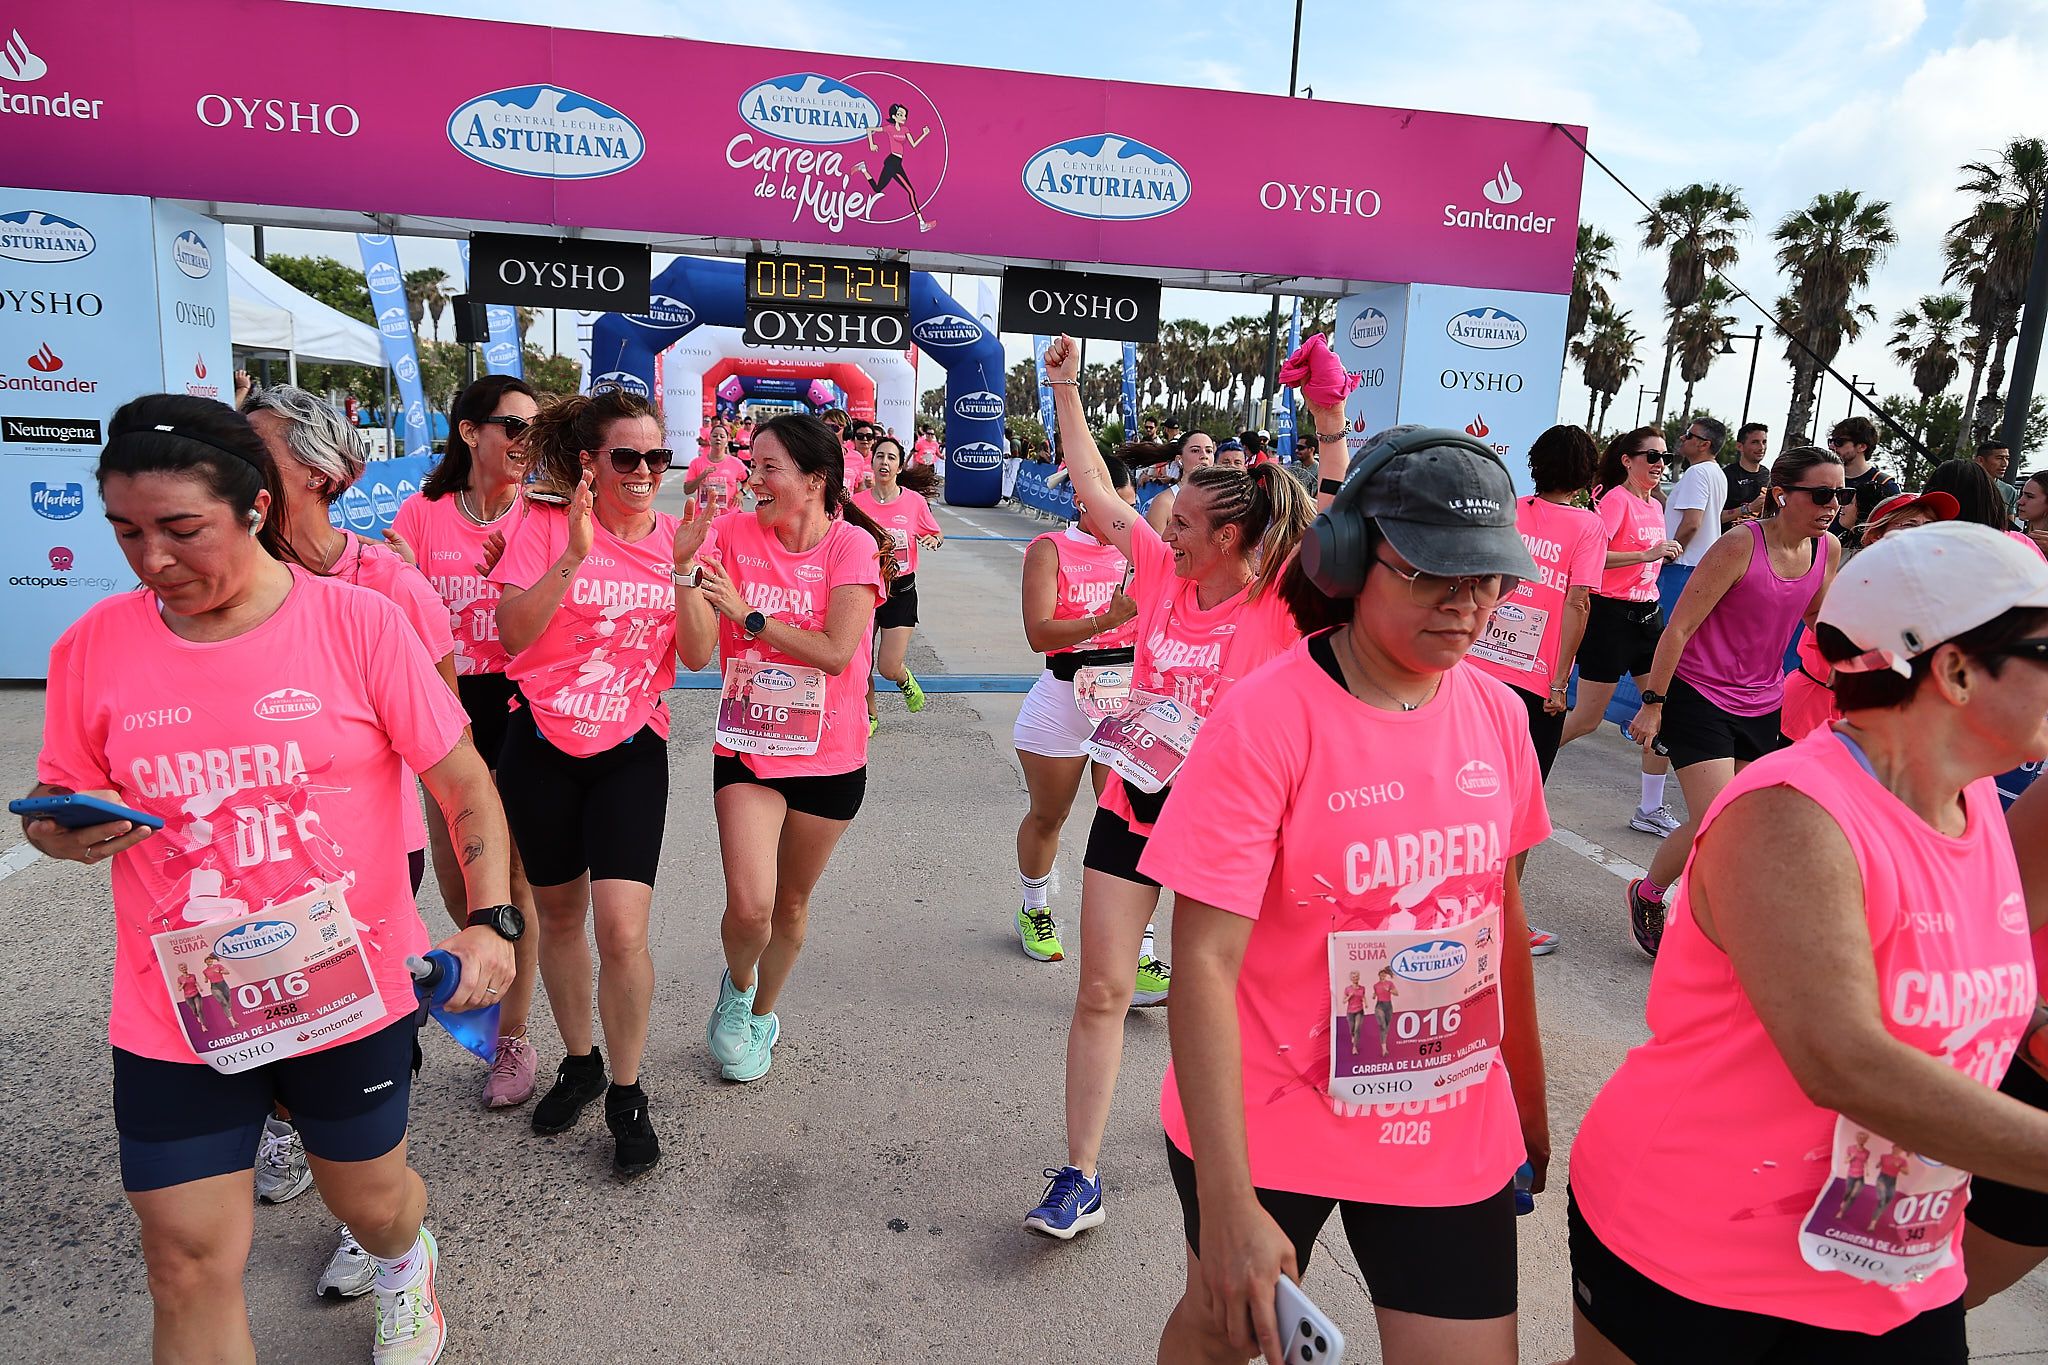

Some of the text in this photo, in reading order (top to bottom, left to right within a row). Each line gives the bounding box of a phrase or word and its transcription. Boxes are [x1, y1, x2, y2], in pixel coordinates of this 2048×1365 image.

[0, 86, 103, 119] tander
[750, 94, 869, 129] ASTURIANA
[772, 94, 867, 109] CENTRAL LECHERA
[196, 94, 360, 137] OYSHO
[494, 113, 624, 133] CENTRAL LECHERA
[464, 113, 630, 159] ASTURIANA
[725, 133, 844, 176] Carrera
[1063, 161, 1174, 177] CENTRAL LECHERA
[1035, 161, 1178, 202] ASTURIANA
[754, 173, 885, 233] de la Mujer
[1259, 181, 1381, 218] OYSHO
[1443, 204, 1556, 234] Santander
[0, 234, 88, 252] STURIANA
[175, 243, 209, 270] ASTURIANA
[498, 258, 626, 292] OYSHO
[757, 260, 900, 302] 00:37:24
[175, 301, 216, 328] OYSHO
[1028, 289, 1138, 322] OYSHO
[753, 310, 903, 346] OYSHO
[918, 326, 979, 339] ASTURIANA
[1351, 324, 1385, 341] ASTURIANA
[1452, 320, 1521, 342] ASTURIANA
[680, 348, 712, 357] OYSHO
[868, 356, 899, 364] OYSHO
[0, 374, 98, 393] Santander
[185, 382, 219, 398] Santander
[1440, 369, 1524, 393] OYSHO
[667, 388, 696, 396] OYSHO
[883, 399, 911, 407] OYSHO
[958, 401, 1002, 414] ASTURIAN
[7, 421, 96, 442] Neutrogena
[956, 451, 1000, 464] ASTURIAN
[33, 490, 81, 510] Marlene
[1448, 498, 1500, 511] LE MARAIS
[431, 551, 462, 561] YSHO
[583, 556, 615, 567] SHO
[736, 554, 774, 571] OYSHO
[1062, 563, 1093, 573] OYSHO
[9, 575, 118, 591] octopus energy
[572, 577, 676, 612] CARRERA
[472, 607, 500, 641] DE
[620, 616, 652, 651] DE
[1492, 628, 1518, 643] 016
[755, 675, 793, 687] ASTURIANA
[260, 701, 317, 715] ASTURIANA
[551, 691, 631, 723] MUJER
[750, 703, 790, 722] 016
[1097, 698, 1123, 710] 016
[123, 706, 192, 732] OYSHO
[571, 720, 601, 738] 2026
[760, 723, 775, 731] 401
[725, 736, 757, 748] OYSHO
[726, 726, 749, 735] CARRERA
[784, 733, 808, 741] VALENCIA
[1121, 723, 1157, 749] 016
[130, 740, 310, 800] CARRERA
[1121, 765, 1149, 786] Santander
[1327, 781, 1405, 813] OYSHO
[233, 801, 293, 868] DE
[1343, 820, 1503, 897] CARRERA
[169, 934, 205, 947] TU DORSAL
[173, 940, 209, 956] SUMA
[222, 929, 292, 956] ASTURIANA
[1358, 941, 1386, 949] DORSAL
[309, 948, 357, 974] CORREDORA
[1349, 949, 1387, 961] SUMA
[1398, 953, 1465, 973] ASTURIANA
[237, 971, 310, 1009] 016
[208, 1031, 250, 1050] CARRERA
[251, 1025, 264, 1037] DE
[266, 1022, 279, 1032] LA
[279, 1012, 310, 1028] MUJER
[316, 992, 358, 1016] VALENCIA
[263, 1003, 299, 1020] 2458
[1396, 1003, 1463, 1039] 016
[310, 1010, 364, 1039] Santander
[216, 1041, 275, 1067] OYSHO
[1352, 1038, 1487, 1075] CARRERA DE LA MUJER VALENCIA
[1419, 1041, 1443, 1056] 673
[1446, 1061, 1488, 1085] Santander
[363, 1079, 394, 1094] KIPRUN
[1352, 1079, 1413, 1096] OYSHO
[1378, 1120, 1431, 1145] 2026
[1893, 1190, 1954, 1225] 016
[1824, 1227, 1874, 1249] CARRERA
[1875, 1240, 1891, 1252] DE
[1891, 1242, 1905, 1254] LA
[1905, 1227, 1926, 1242] 343
[1816, 1243, 1885, 1272] OYSHO
